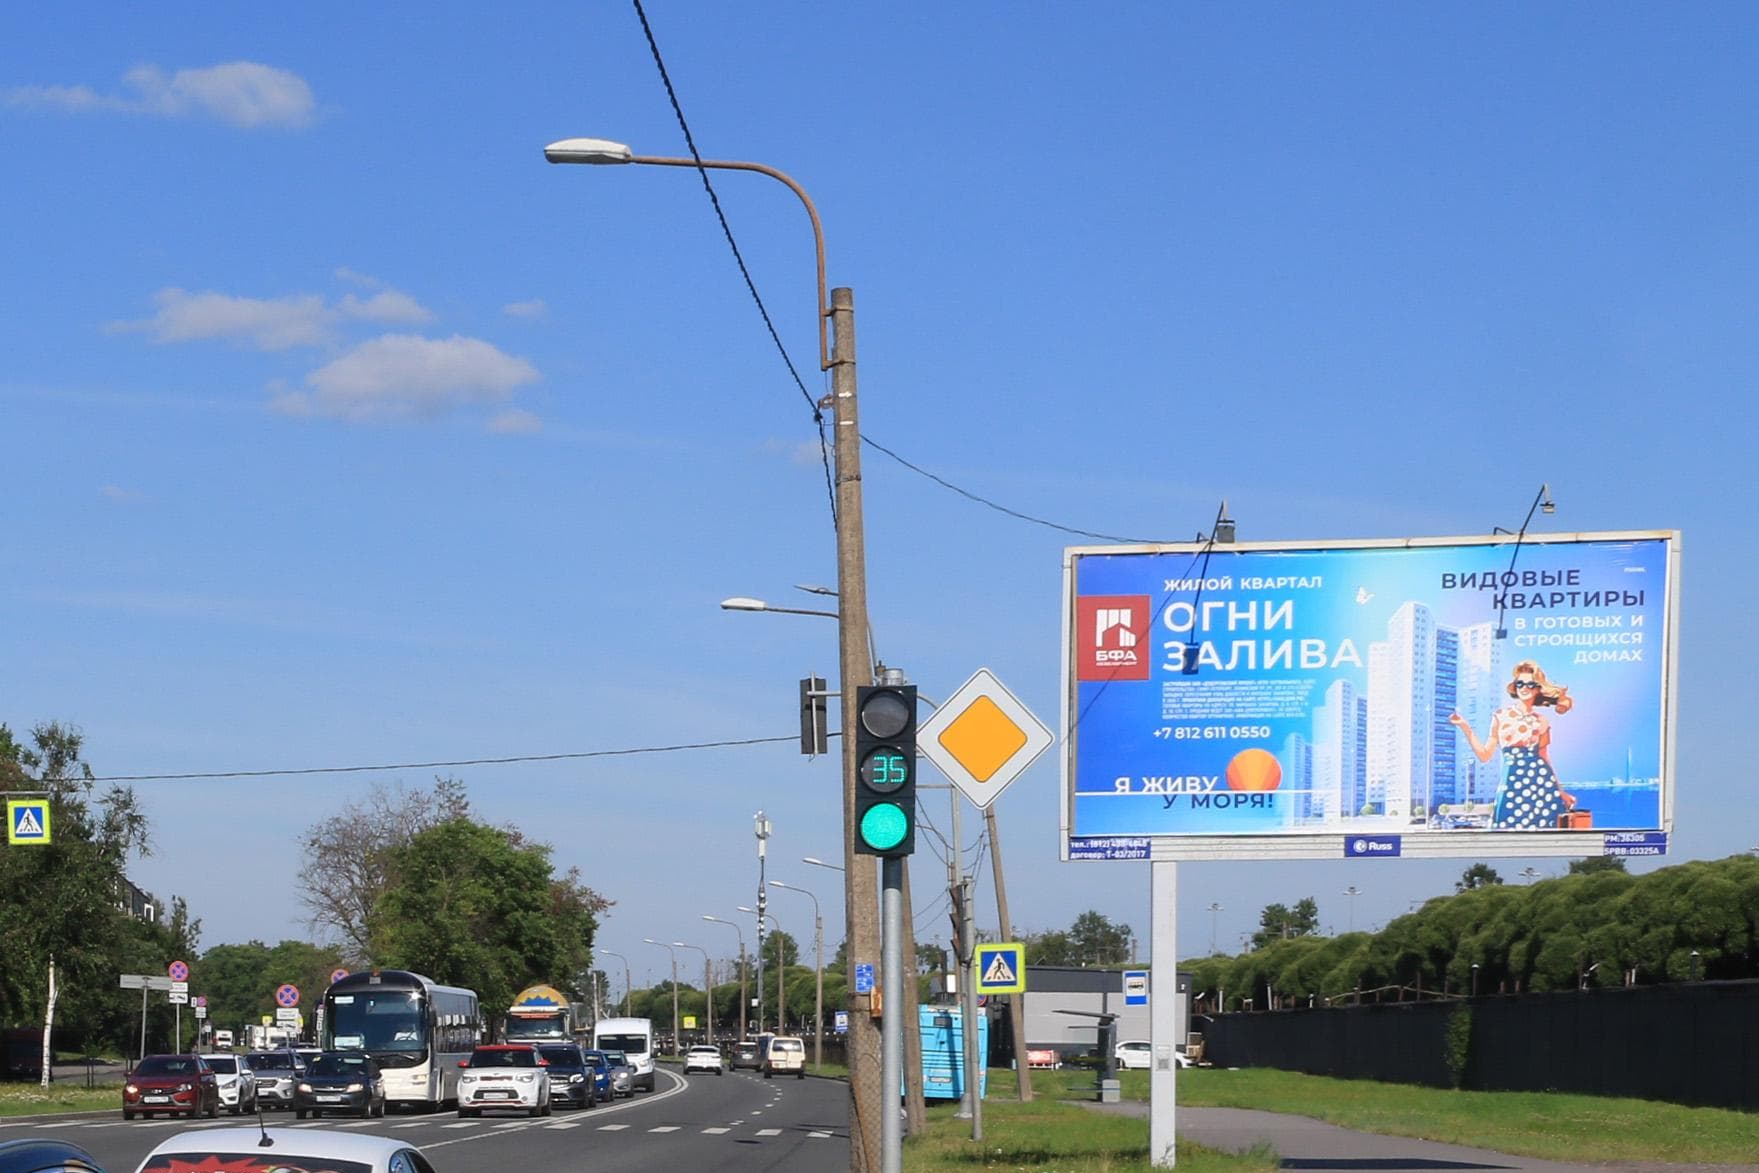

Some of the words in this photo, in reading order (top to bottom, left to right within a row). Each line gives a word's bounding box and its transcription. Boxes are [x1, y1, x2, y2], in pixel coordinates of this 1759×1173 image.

[1163, 575, 1233, 592] ЖИЛОЙ
[1240, 576, 1322, 590] КВАРТАЛ
[1442, 569, 1581, 591] ВИДОВЫЕ
[1493, 590, 1644, 609] КВАРТИРЫ
[1163, 600, 1293, 632] ОГНИ
[1514, 617, 1526, 630] В
[1534, 615, 1622, 629] ГОТОВЫХ
[1631, 614, 1643, 626] И
[1514, 632, 1643, 647] СТРОЯЩИХСЯ
[1095, 650, 1137, 661] БФА
[1162, 639, 1363, 671] ЗАЛИВА
[1574, 650, 1643, 665] ДОМАХ
[1153, 727, 1172, 739] +7
[1174, 727, 1201, 739] 812
[1203, 726, 1226, 738] 611
[1230, 726, 1271, 738] 0550
[873, 756, 905, 783] 35
[1115, 776, 1131, 793] Я
[1141, 776, 1219, 793] ЖИВУ
[1162, 794, 1178, 809] У
[1191, 793, 1273, 809] МОРЯ!
[1369, 841, 1393, 851] Russ
